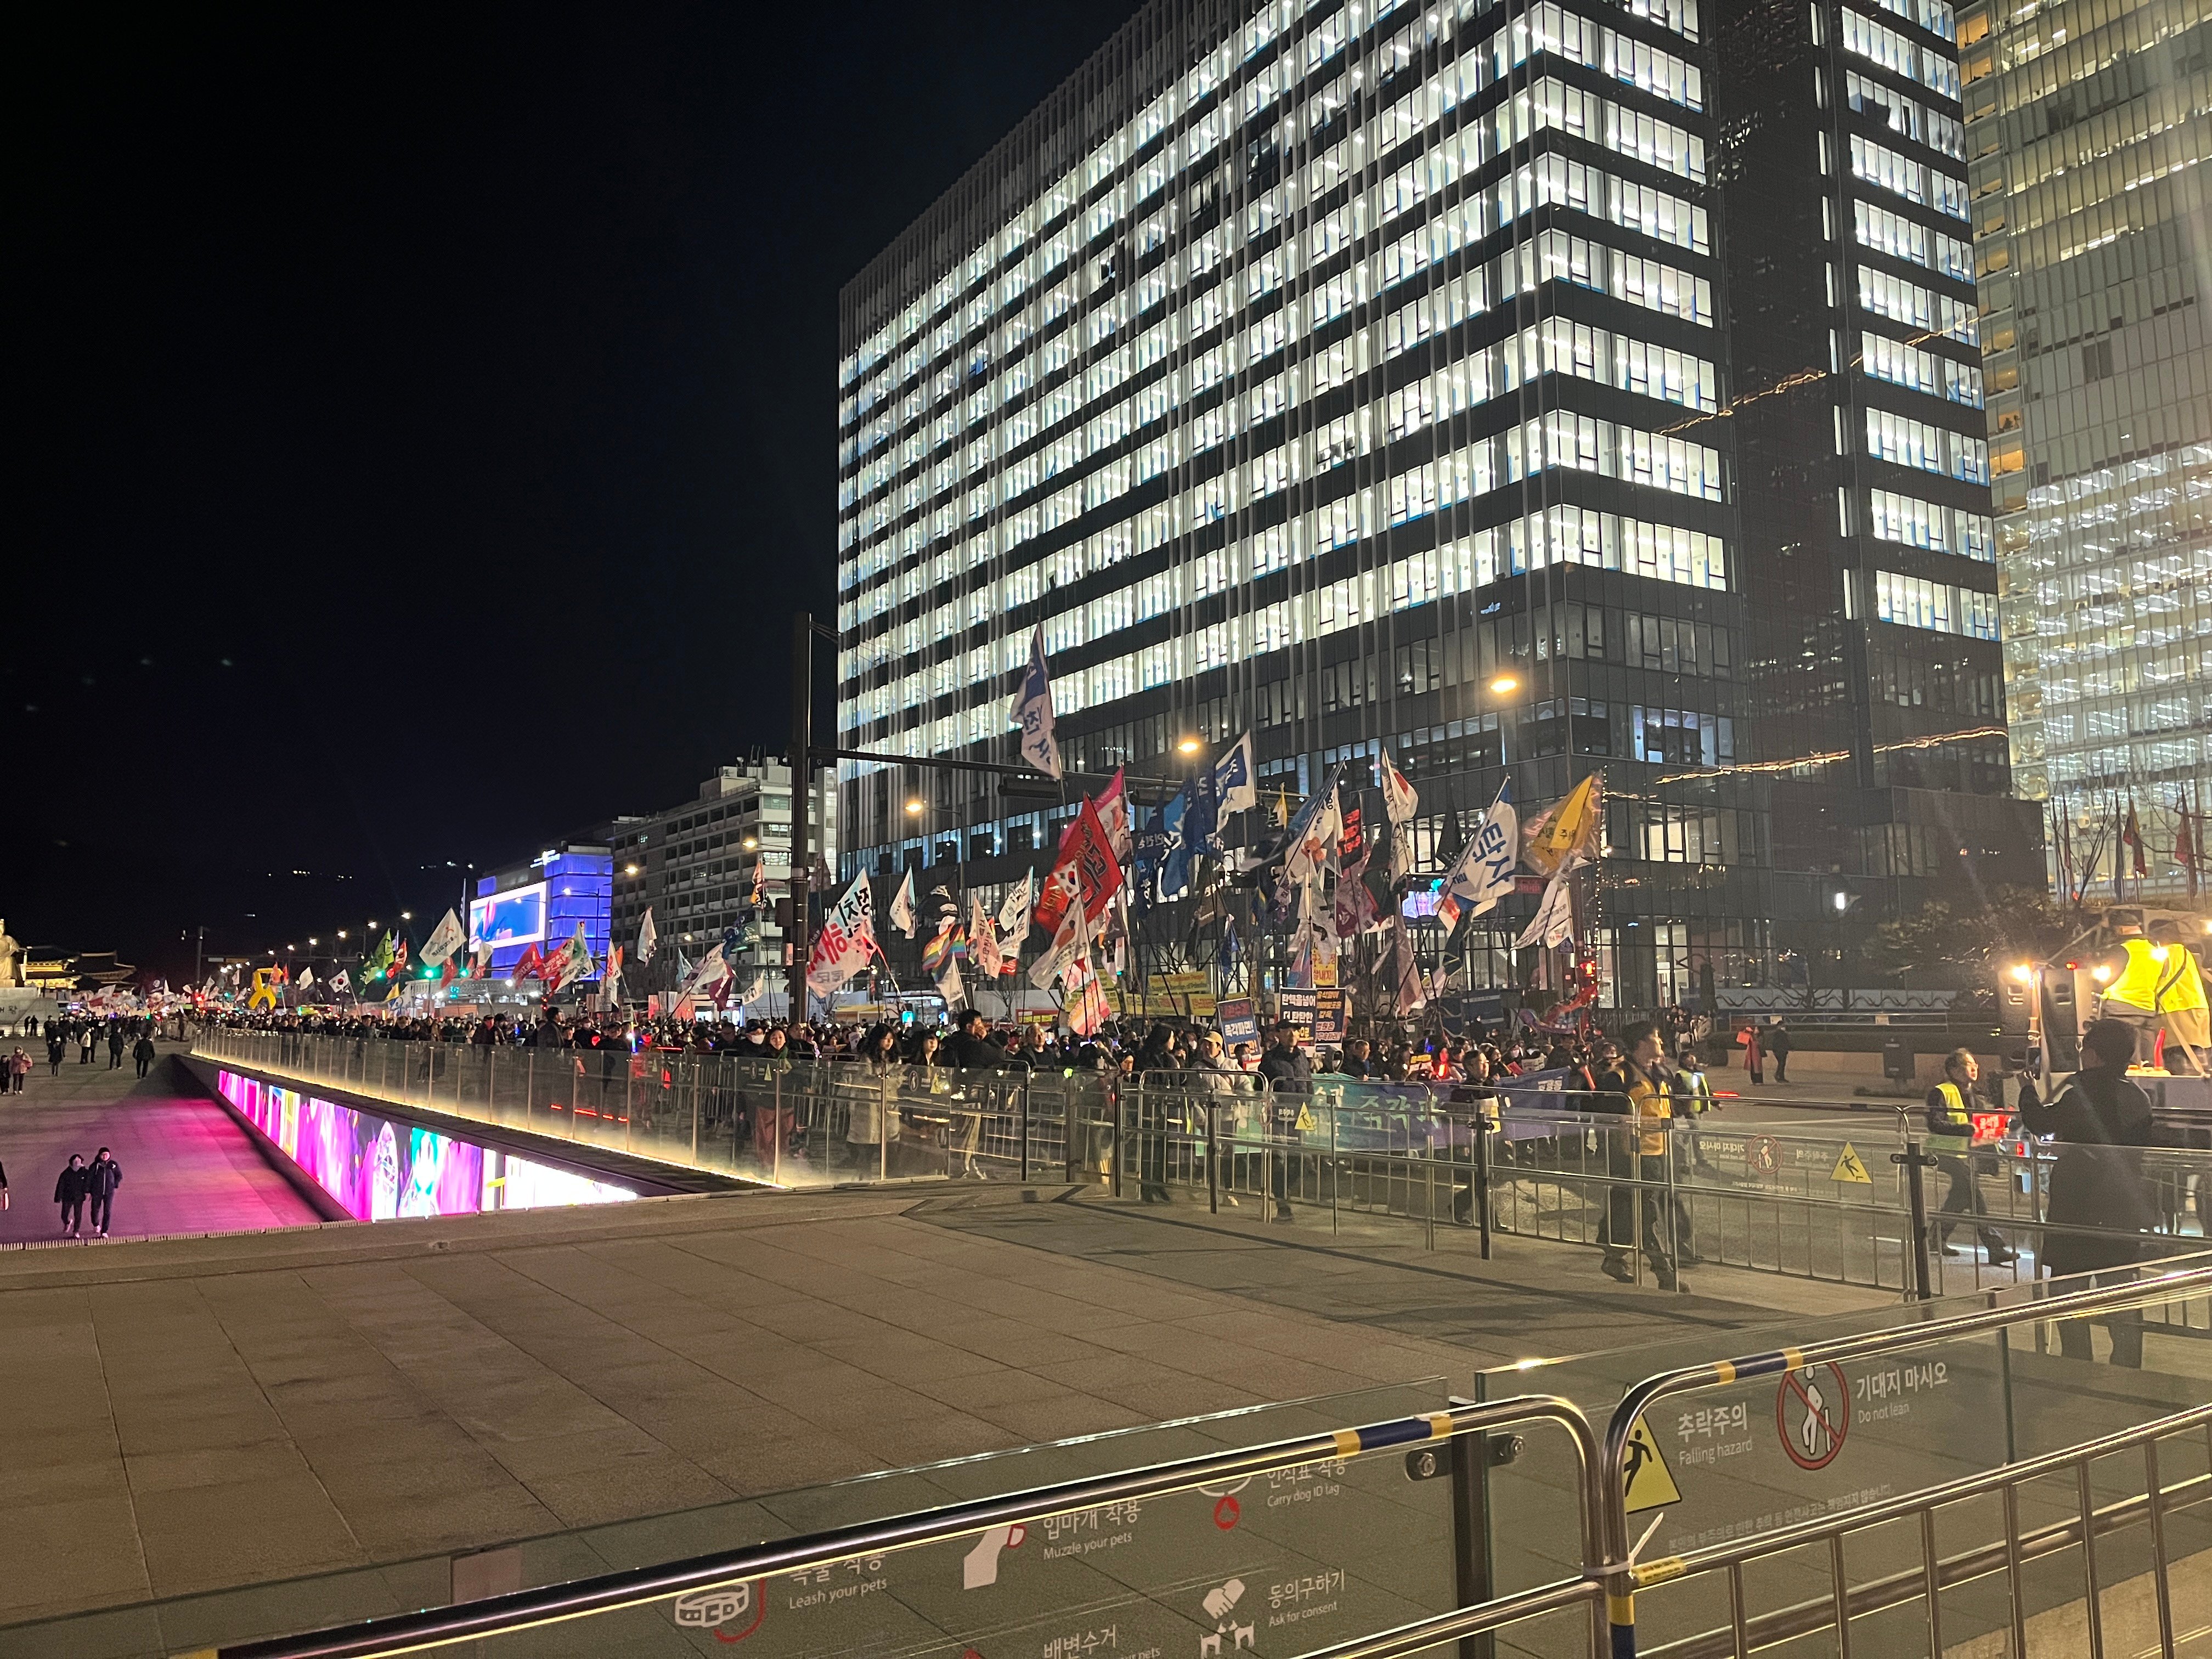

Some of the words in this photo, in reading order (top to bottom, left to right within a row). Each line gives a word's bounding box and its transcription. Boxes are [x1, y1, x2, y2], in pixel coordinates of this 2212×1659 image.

[1225, 1021, 1254, 1036] 즉각파면!
[1857, 1369, 1900, 1401] 기대지
[1906, 1362, 1949, 1393] 마시오
[1678, 1402, 1747, 1443] 추락주의
[1858, 1410, 1871, 1424] Do
[1874, 1407, 1888, 1421] not
[1890, 1402, 1910, 1417] lean
[1679, 1445, 1715, 1466] Falling
[1717, 1439, 1752, 1459] hazard
[1267, 1493, 1292, 1507] Carry
[1294, 1488, 1312, 1502] dog
[1313, 1485, 1323, 1497] ID
[1325, 1483, 1340, 1496] tag
[1043, 1510, 1098, 1540] 입마개
[1105, 1499, 1142, 1526] 착용
[1043, 1542, 1081, 1560] Muzzle
[1084, 1538, 1108, 1555] your
[1110, 1532, 1132, 1548] pets
[789, 1590, 826, 1610] Leash
[828, 1584, 858, 1604] your
[861, 1578, 887, 1597] pets
[1267, 1568, 1346, 1609] 동의구하기
[1269, 1614, 1285, 1628] Ask
[1287, 1610, 1301, 1623] for
[1302, 1600, 1338, 1619] consent
[1043, 1624, 1116, 1659] 배변수거
